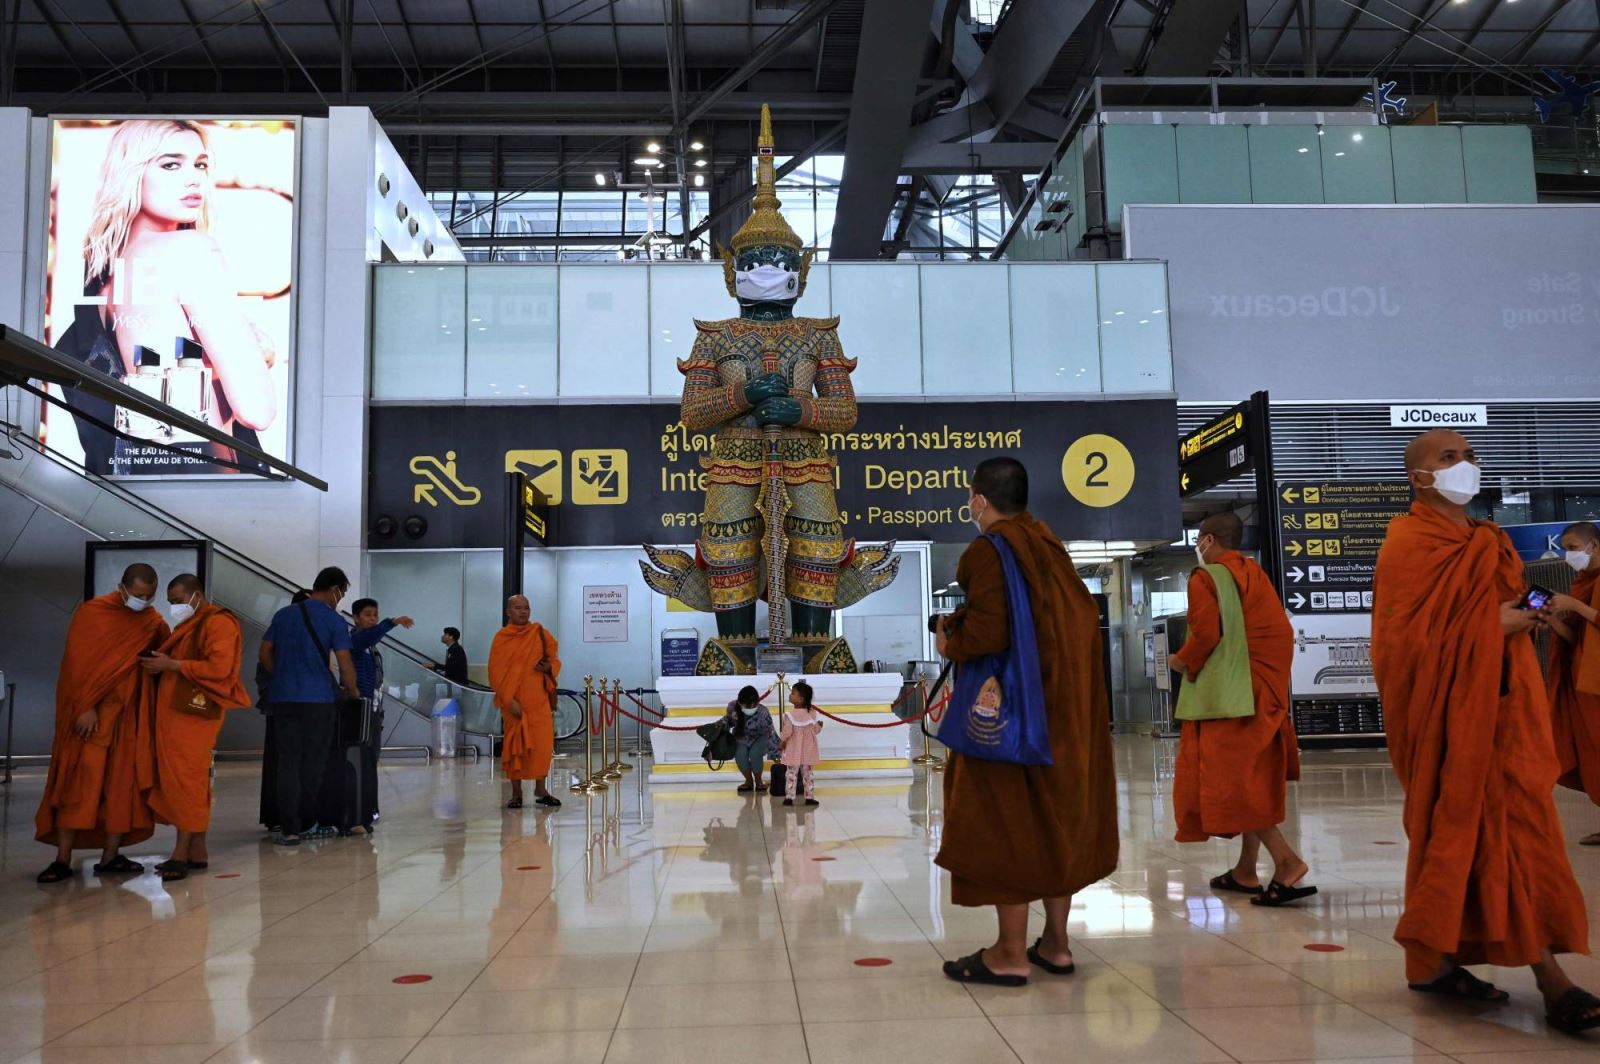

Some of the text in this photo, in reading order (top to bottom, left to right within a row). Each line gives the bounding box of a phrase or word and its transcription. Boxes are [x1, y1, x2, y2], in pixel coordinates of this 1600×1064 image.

[1400, 409, 1477, 423] JCDecaux
[125, 447, 140, 455] THE
[141, 447, 157, 455] EAU
[117, 457, 132, 465] THE
[133, 457, 152, 465] NEW
[154, 456, 169, 464] EAU
[171, 456, 182, 464] DE
[1085, 451, 1109, 487] 2
[865, 464, 970, 495] Departu
[1321, 495, 1348, 503] Domestic
[1349, 495, 1380, 504] Departures
[869, 507, 952, 528] Passport
[1350, 575, 1371, 583] Baggage
